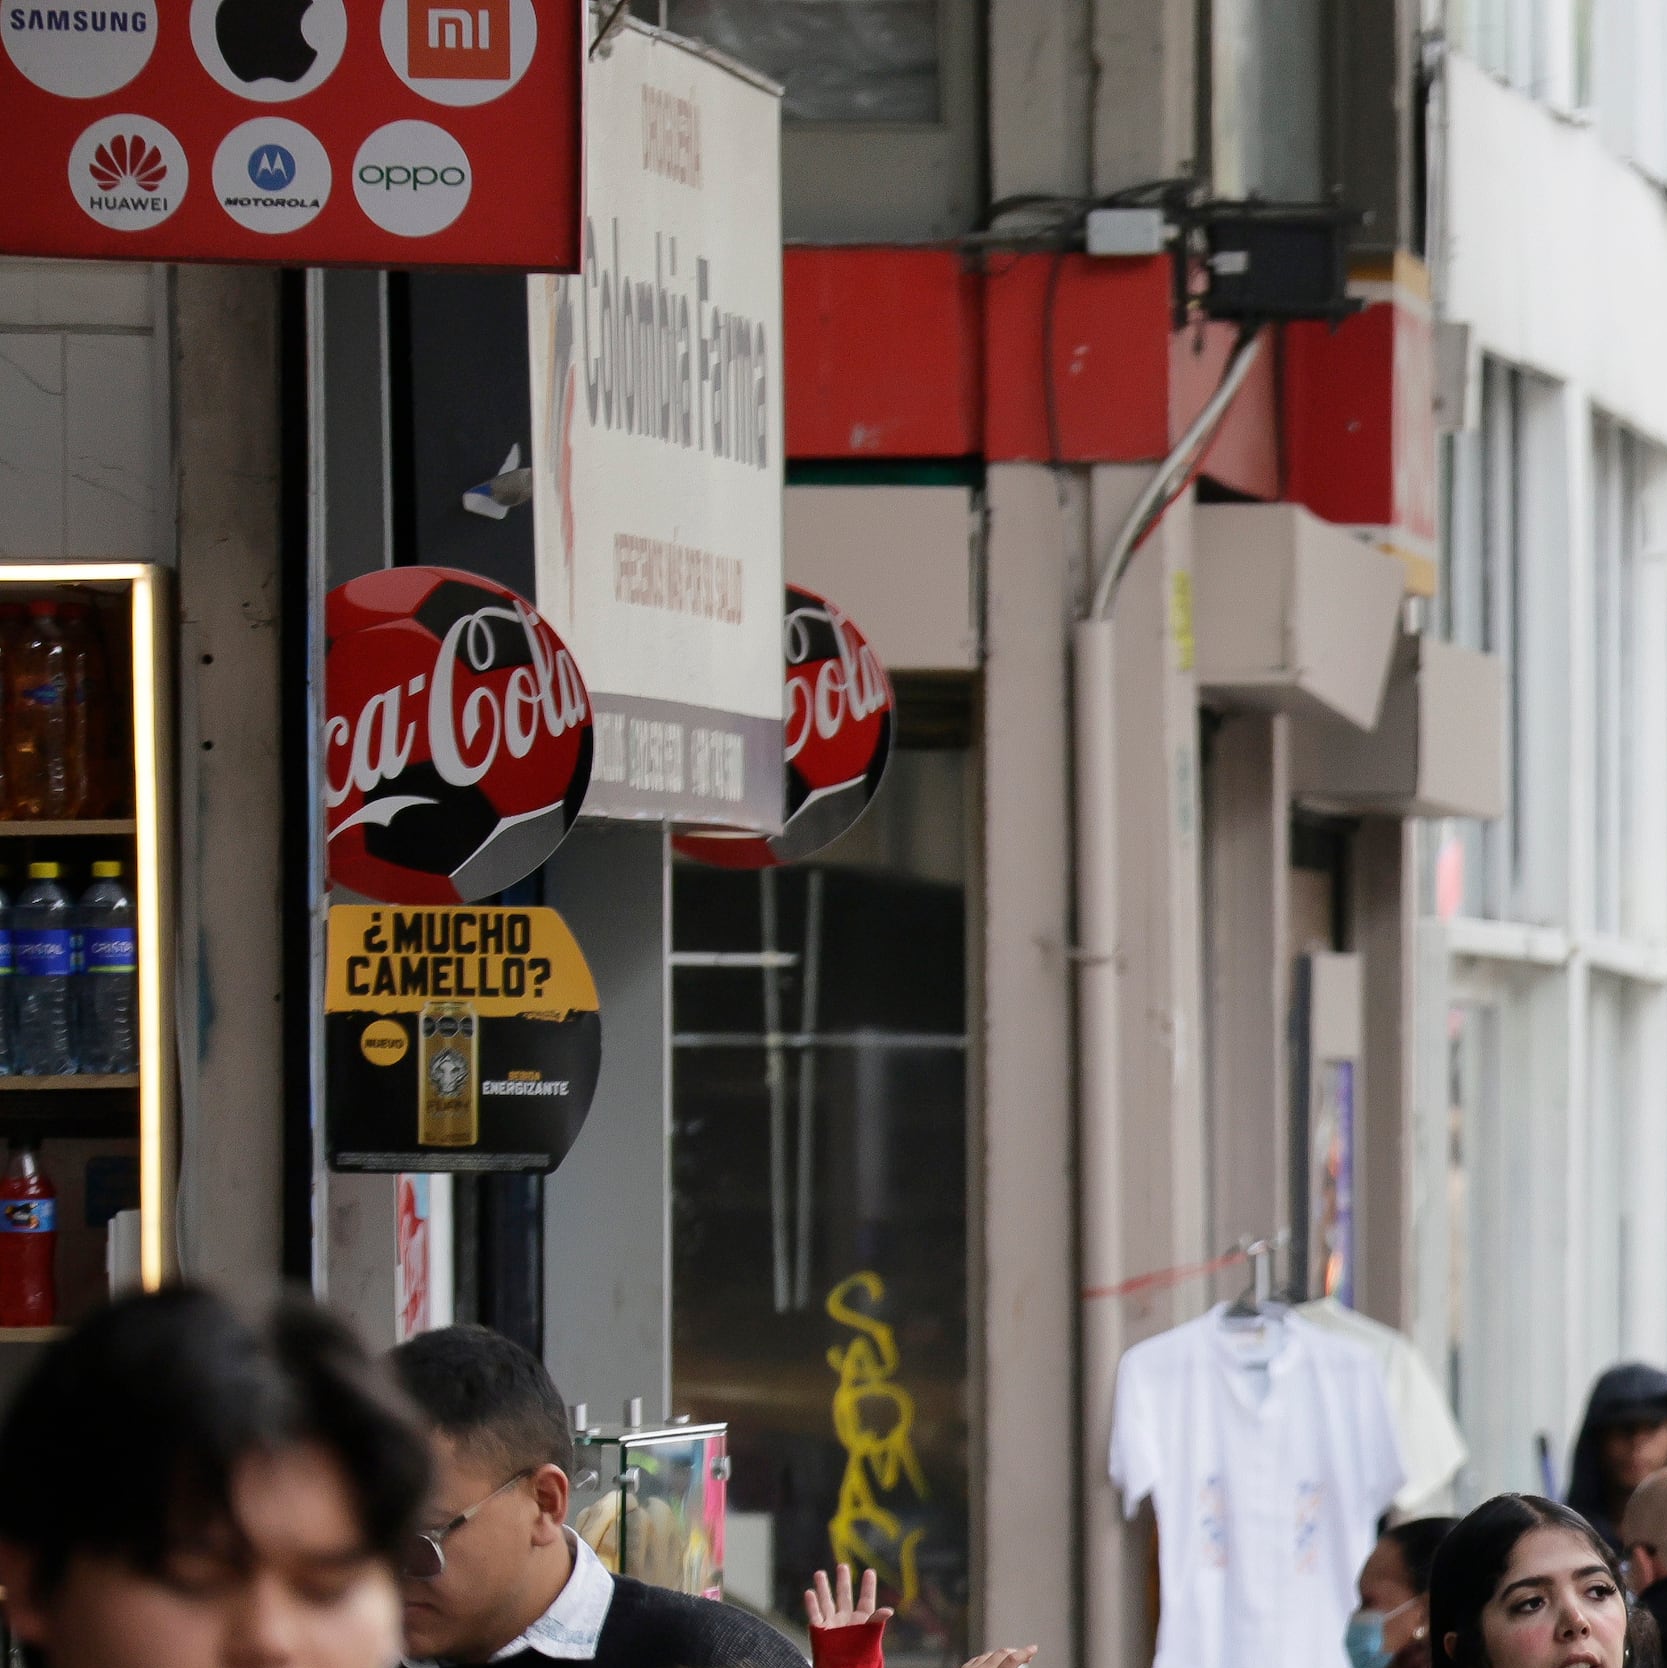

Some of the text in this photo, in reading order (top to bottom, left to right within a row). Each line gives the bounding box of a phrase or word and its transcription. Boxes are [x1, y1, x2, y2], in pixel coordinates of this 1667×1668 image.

[10, 8, 147, 33] SAMSUNG
[90, 197, 168, 212] HUAWEI
[224, 197, 320, 208] MOTOROLA
[583, 215, 768, 471] Colombia Farma
[325, 598, 587, 808] ca-Cola
[363, 911, 532, 955] ¿MUCHO
[345, 955, 552, 999] CAMELLO?
[482, 1080, 570, 1096] ENERGIZANTE
